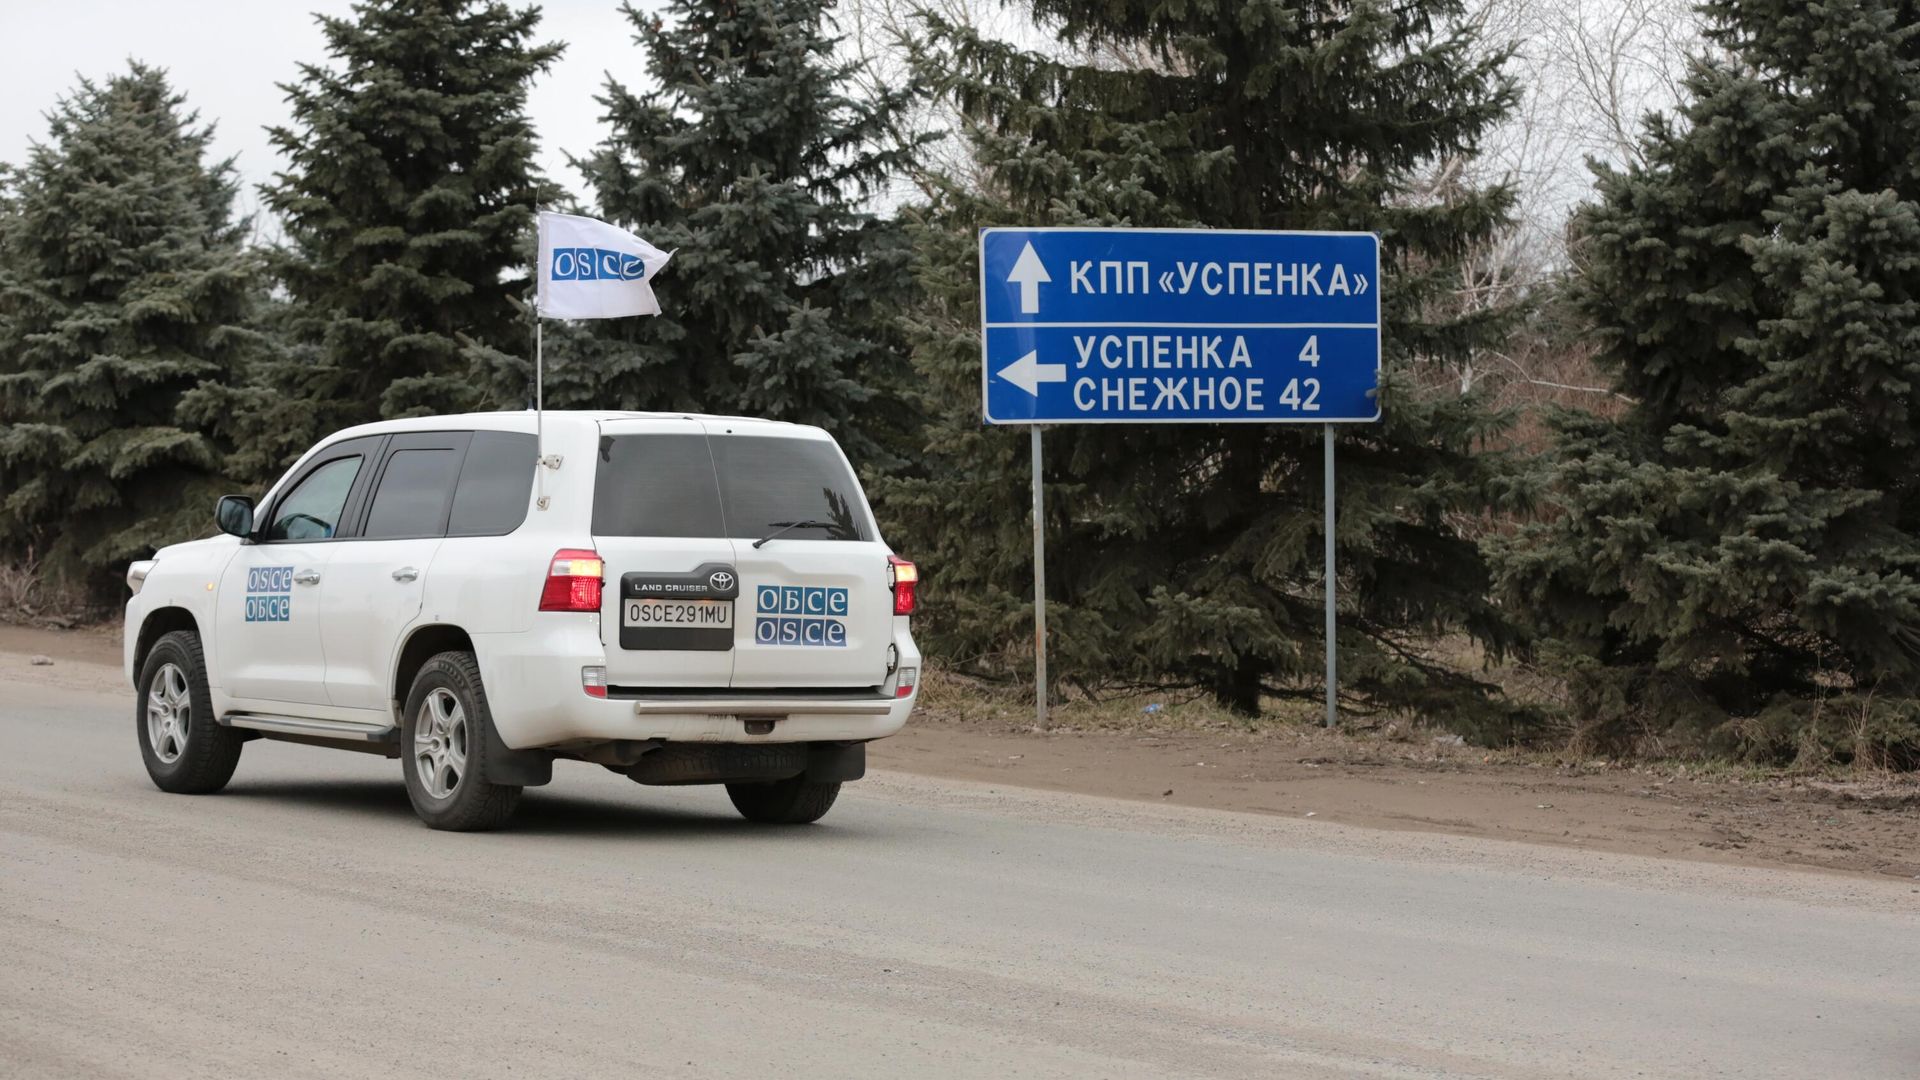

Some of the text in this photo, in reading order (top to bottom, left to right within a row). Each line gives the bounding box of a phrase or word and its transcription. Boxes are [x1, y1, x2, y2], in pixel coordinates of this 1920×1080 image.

[1070, 260, 1369, 296] КПП «УСПЕНКА»
[1073, 335, 1320, 369] УСПЕНКА 4
[1073, 376, 1321, 411] СНЕЖНОЕ 42
[665, 584, 708, 592] CRUISER
[630, 604, 727, 624] OSCE291MU
